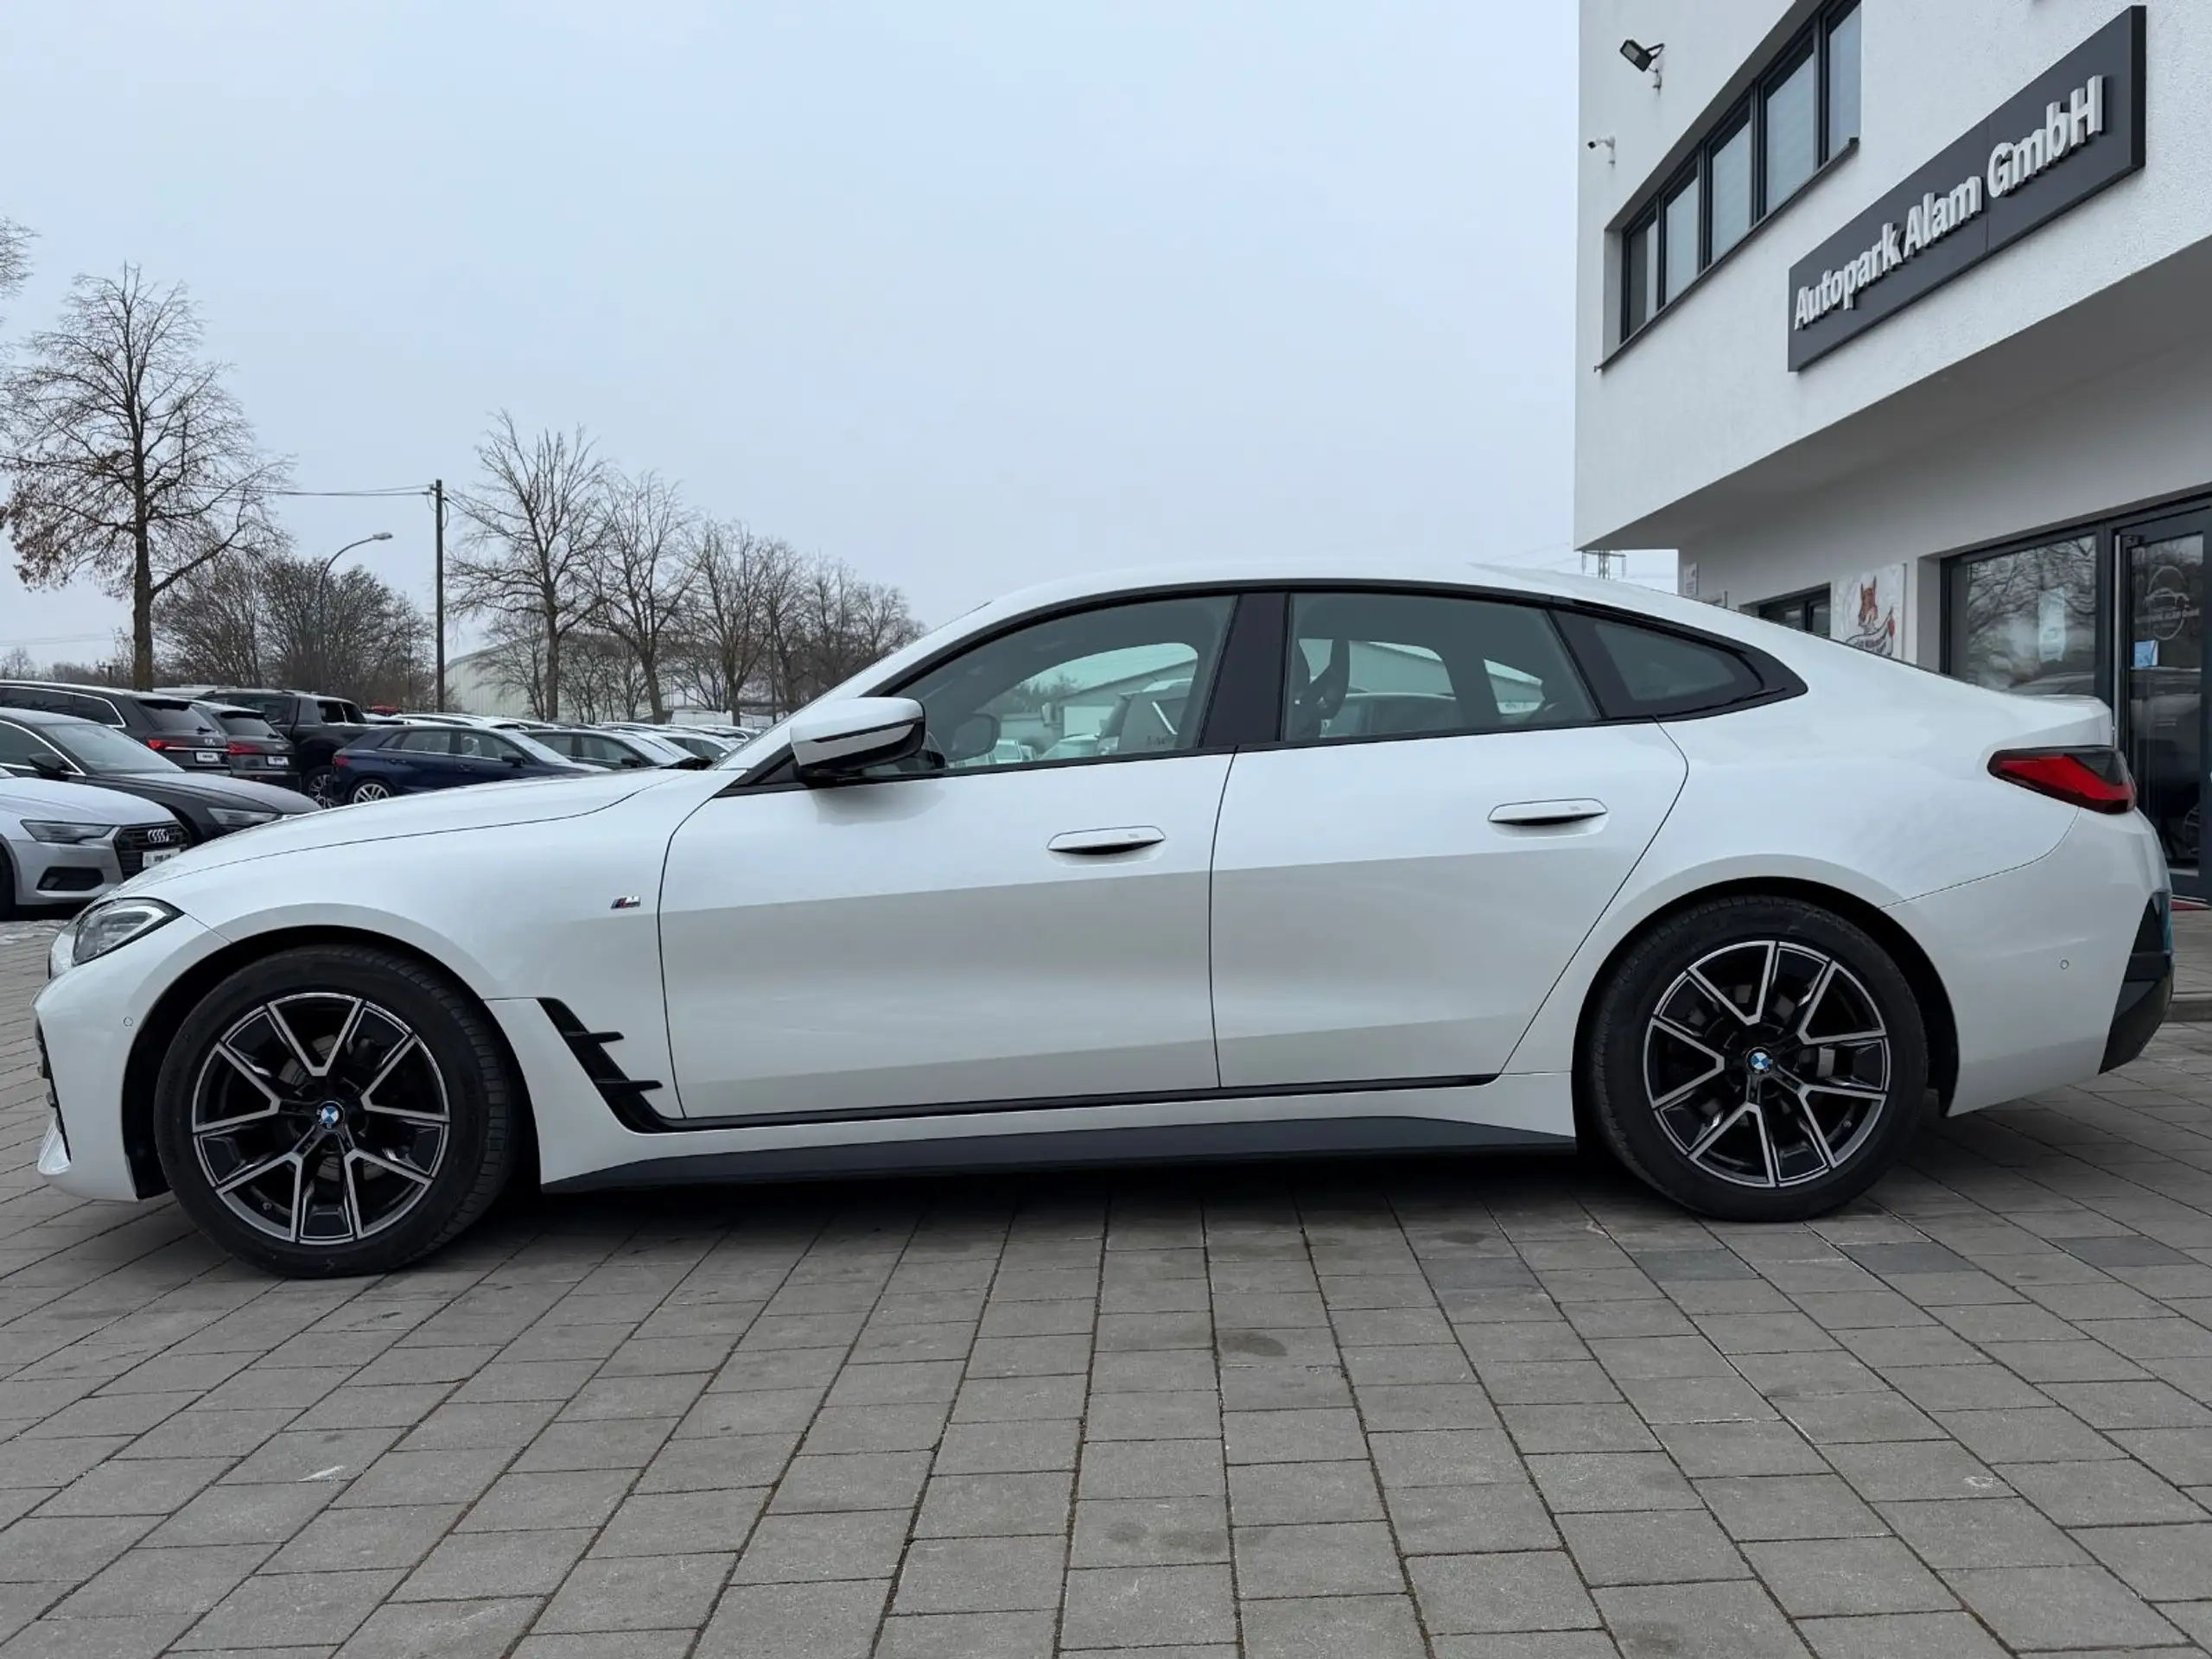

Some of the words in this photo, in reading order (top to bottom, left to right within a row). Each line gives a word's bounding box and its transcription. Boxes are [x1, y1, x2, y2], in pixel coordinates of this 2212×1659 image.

[1794, 222, 1903, 330] Autopark
[1904, 175, 1982, 258] Alam
[1987, 74, 2103, 198] GmbH
